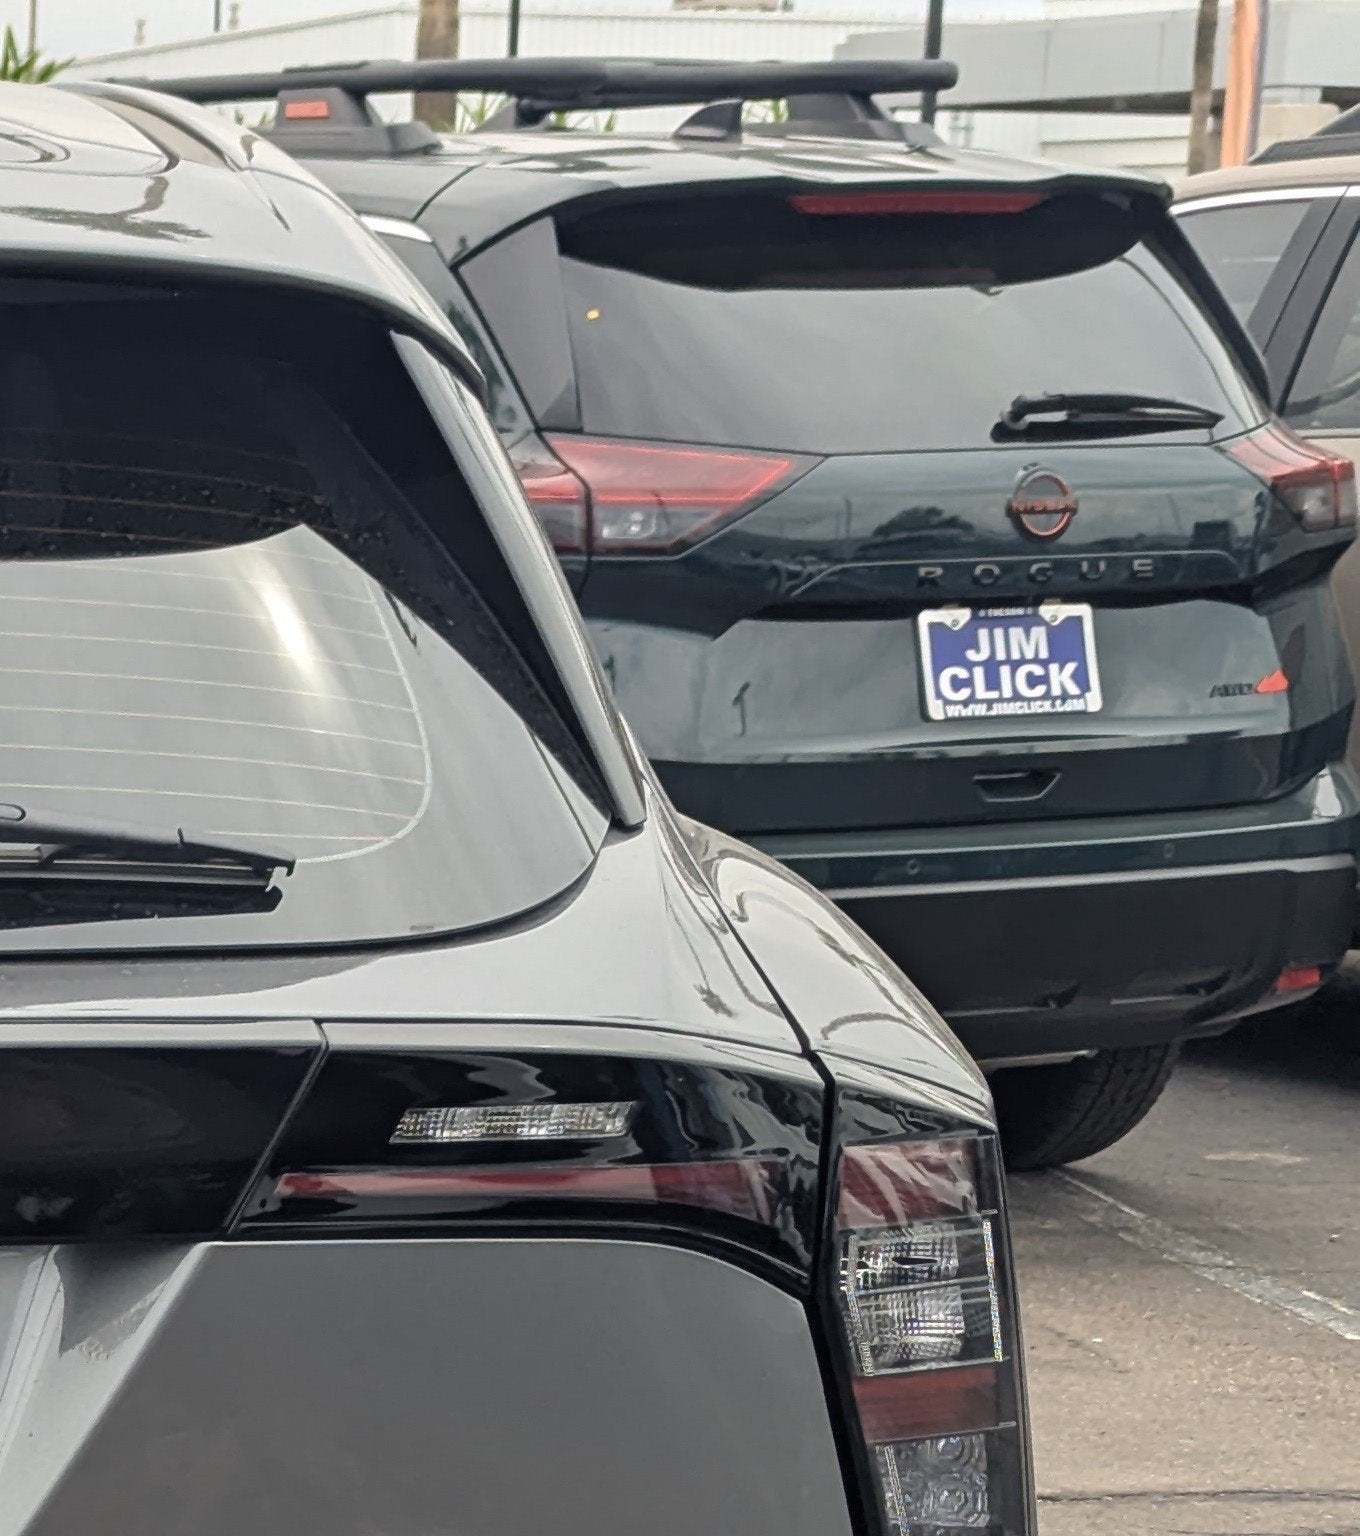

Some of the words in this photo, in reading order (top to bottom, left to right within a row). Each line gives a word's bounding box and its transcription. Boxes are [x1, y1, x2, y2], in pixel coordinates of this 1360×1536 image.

[917, 558, 1155, 588] ROGUE
[964, 625, 1050, 662] JIM
[938, 661, 1083, 701] CLICK
